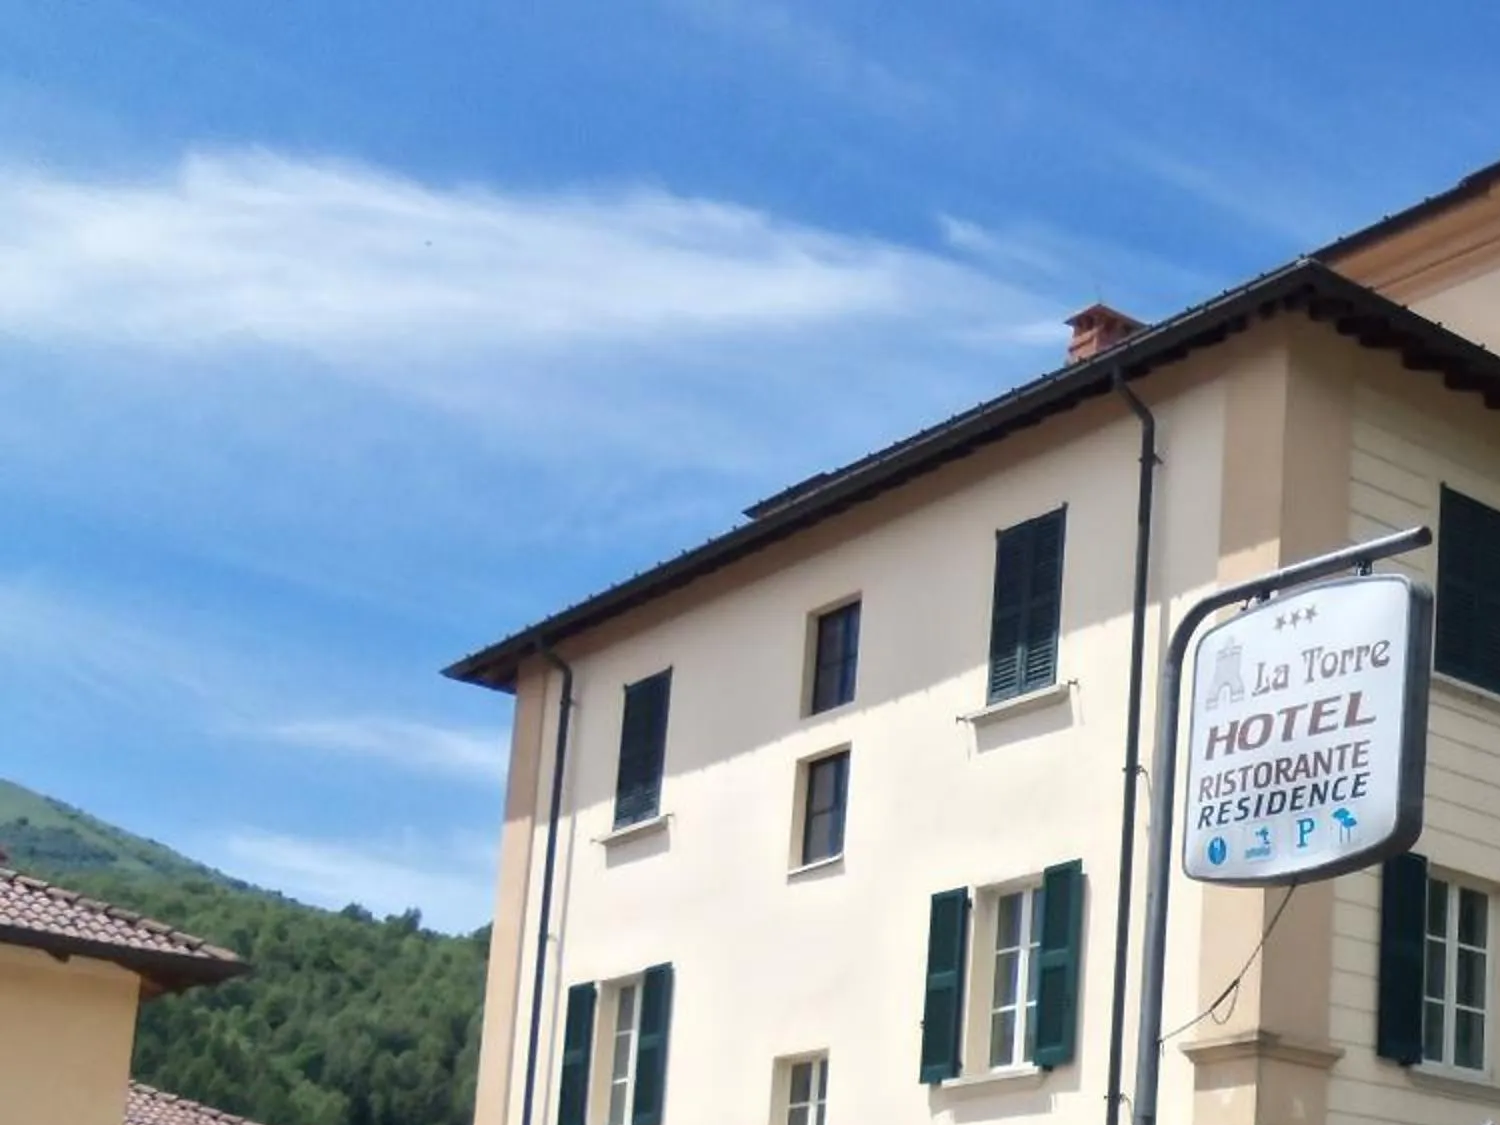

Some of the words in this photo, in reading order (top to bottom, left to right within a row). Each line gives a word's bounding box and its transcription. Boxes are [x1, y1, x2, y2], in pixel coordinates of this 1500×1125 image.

[1252, 662, 1289, 697] La
[1302, 639, 1391, 684] Torre
[1205, 691, 1377, 761] HOTEL
[1199, 740, 1372, 802] RISTORANTE
[1197, 772, 1371, 829] RESIDENCE
[1296, 818, 1316, 848] P
